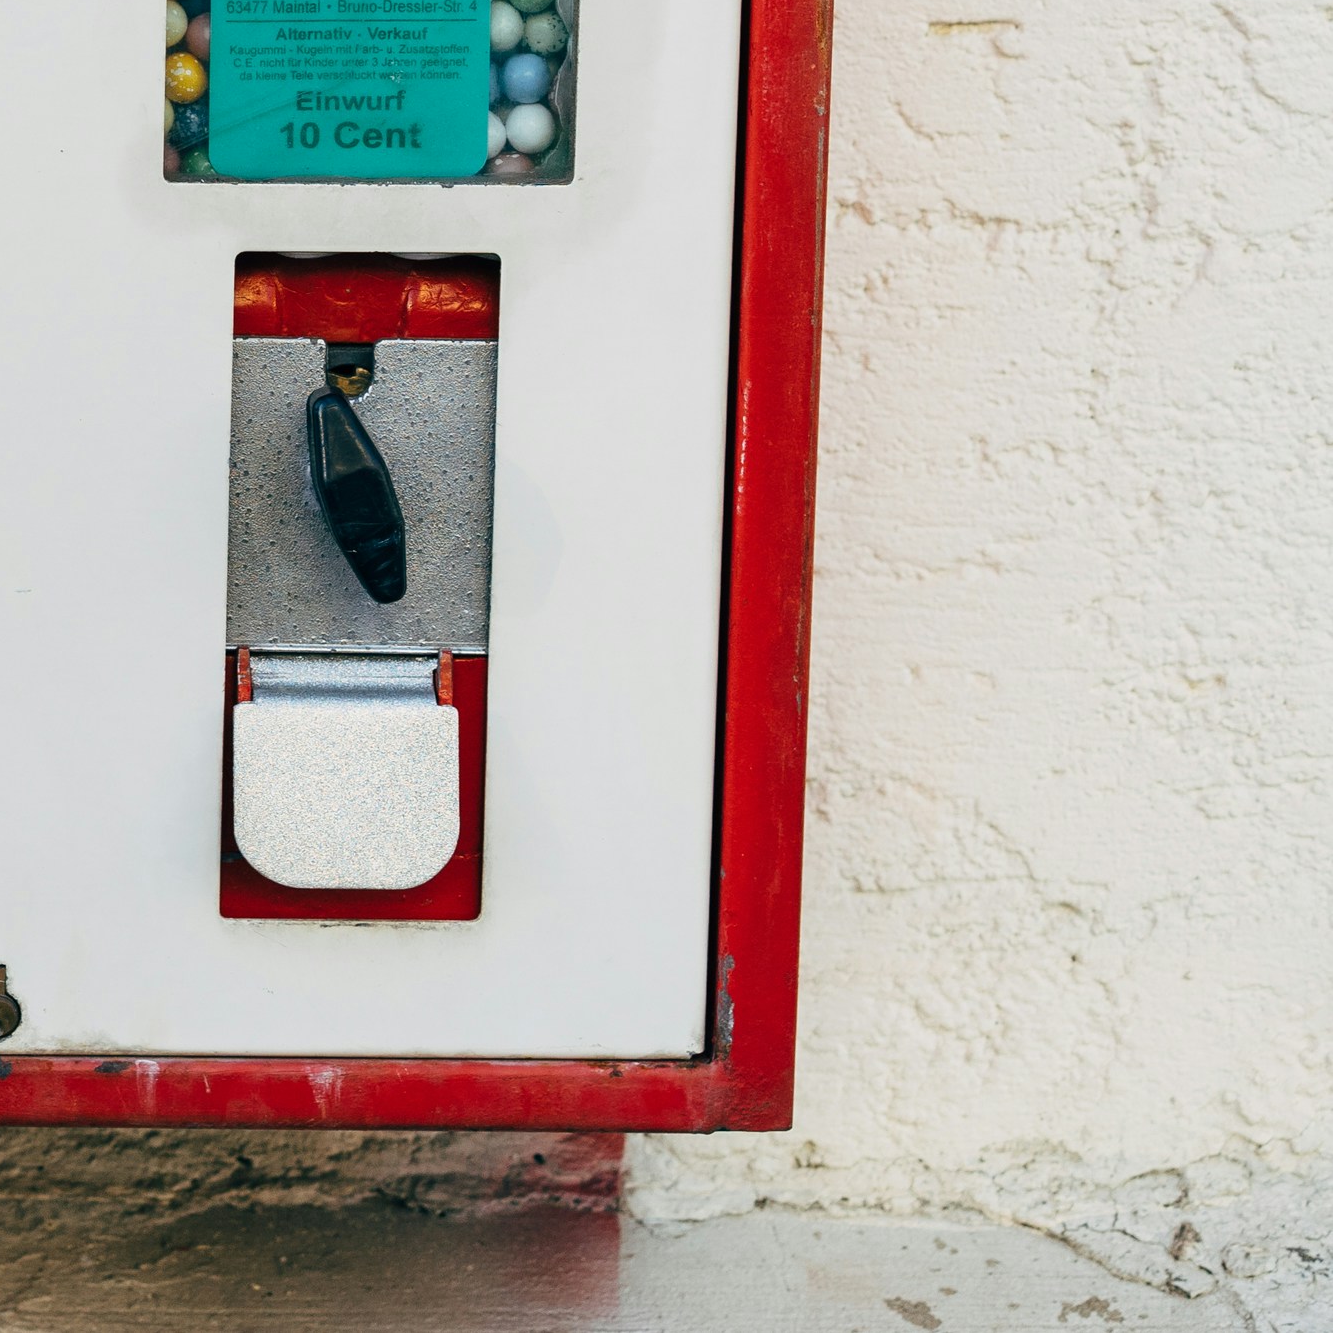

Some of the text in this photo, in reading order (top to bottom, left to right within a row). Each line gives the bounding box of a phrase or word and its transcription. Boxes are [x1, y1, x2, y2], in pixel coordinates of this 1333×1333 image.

[226, 0, 478, 14] 63477 Maintal Bruno-Dressler-Str. 4
[276, 27, 429, 41] Alternativ Verkauf
[229, 45, 287, 57] Kaugummi
[296, 45, 333, 57] Kugeln
[335, 45, 352, 54] mit
[260, 57, 285, 67] nicht
[288, 57, 302, 67] für
[305, 57, 339, 67] Kinder
[372, 57, 379, 67] 3
[381, 57, 417, 67] Jahren
[296, 89, 407, 111] Einwurf
[280, 121, 422, 149] 10 Cent
